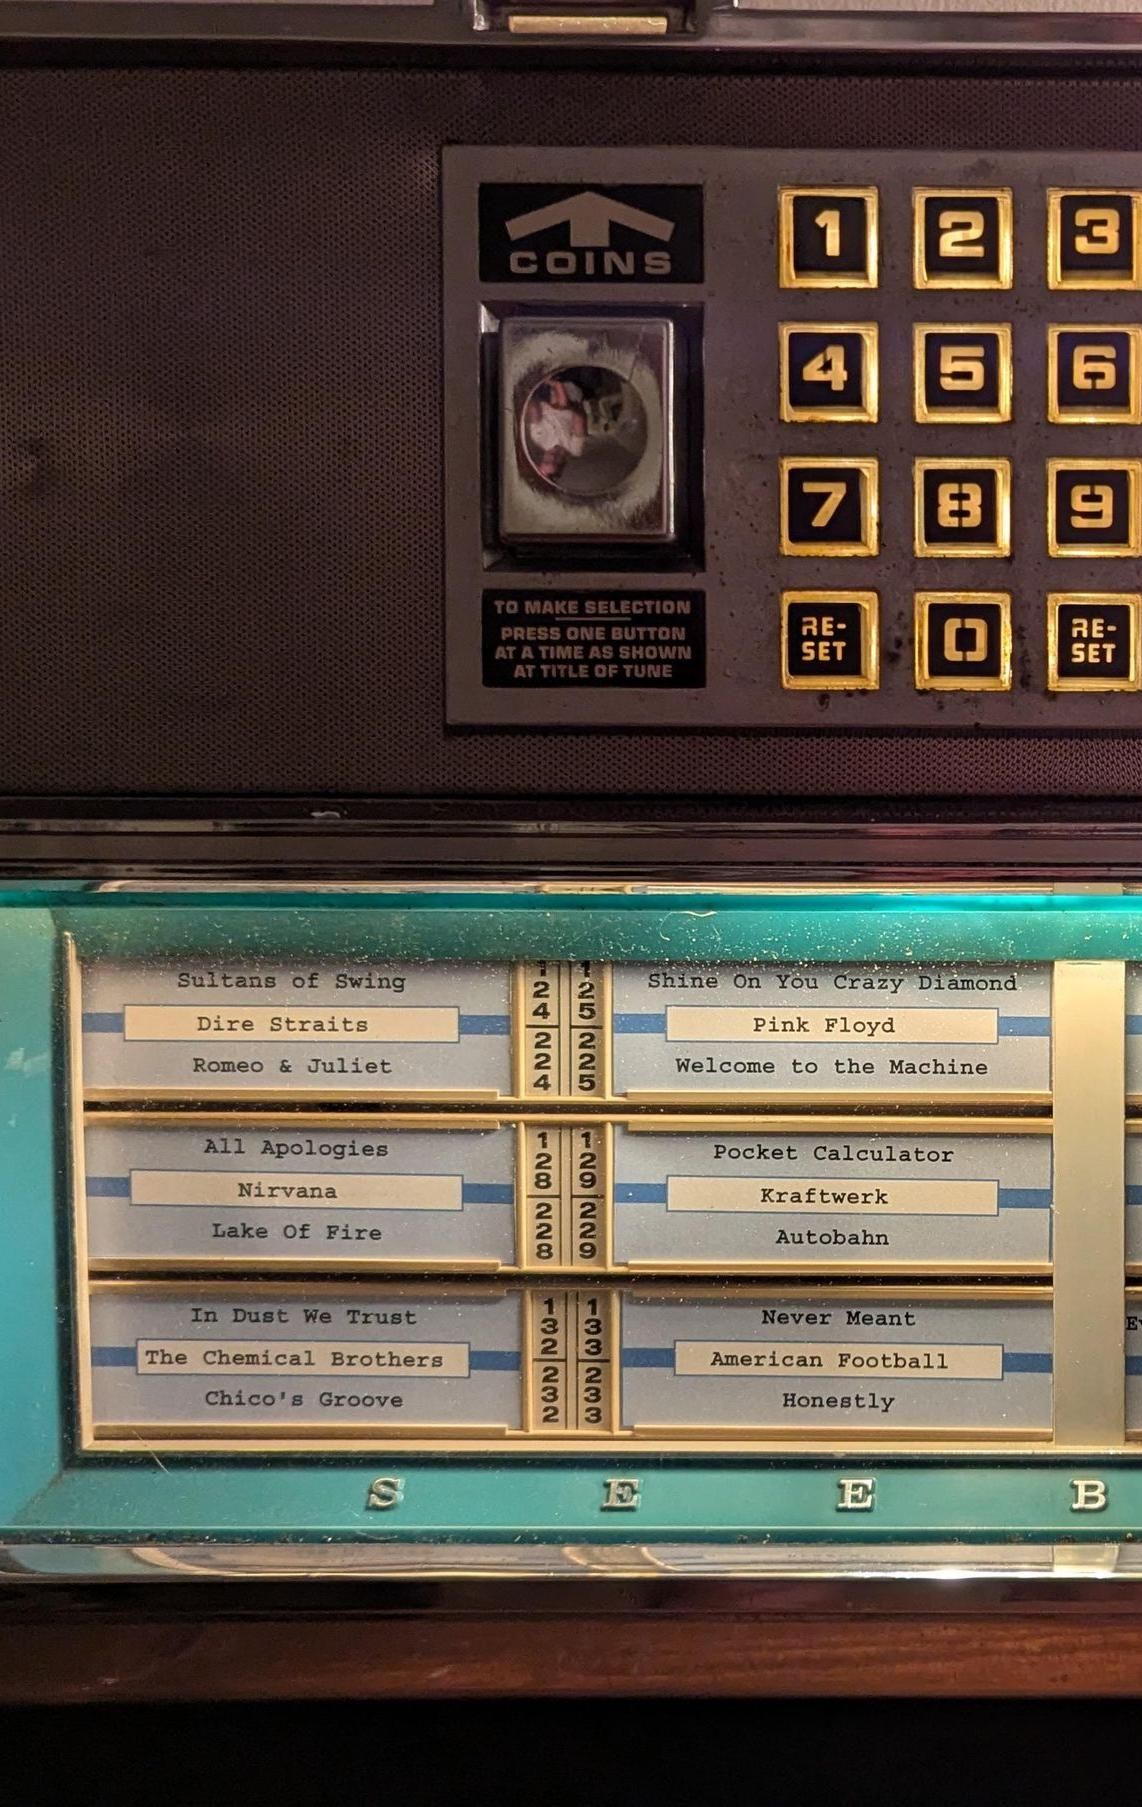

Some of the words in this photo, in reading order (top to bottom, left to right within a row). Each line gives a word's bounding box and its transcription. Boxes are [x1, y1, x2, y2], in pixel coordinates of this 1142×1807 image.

[815, 211, 840, 256] 1
[938, 211, 985, 257] 2
[1075, 209, 1119, 254] 3
[509, 252, 672, 275] COINS
[802, 346, 848, 391] 4
[939, 346, 985, 391] 5
[1072, 346, 1116, 390] 6
[802, 482, 847, 527] 7
[937, 482, 982, 527] 8
[1070, 485, 1114, 528] 9
[494, 601, 518, 614] TO
[525, 601, 578, 614] MAKE
[585, 601, 691, 614] SELECTION
[501, 627, 561, 640] PRESS
[566, 627, 605, 640] ONE
[611, 627, 685, 640] BUTTON
[943, 618, 987, 662] 0
[495, 646, 516, 660] AT
[521, 646, 534, 659] A
[539, 646, 584, 659] TIME
[589, 646, 613, 660] AS
[619, 646, 691, 660] SHOWN
[514, 665, 536, 678] AT
[541, 665, 588, 678] TITLE
[594, 665, 618, 678] OF
[624, 665, 672, 678] TUNE
[178, 973, 276, 990] Sultans
[292, 973, 318, 989] of
[335, 973, 406, 993] Swing
[648, 973, 718, 990] Shine
[734, 974, 761, 990] On
[777, 974, 818, 991] You
[834, 974, 904, 994] Crazy
[919, 974, 1017, 992] Diamond
[198, 1016, 254, 1032] Dire
[270, 1016, 368, 1032] Straits
[754, 1017, 810, 1032] Pink
[826, 1017, 895, 1035] Floyd
[193, 1058, 263, 1073] Romeo
[307, 1058, 393, 1074] Juliet
[675, 1058, 775, 1074] Welcome
[792, 1060, 817, 1074] to
[834, 1059, 875, 1075] the
[889, 1060, 988, 1076] Machine
[204, 1139, 246, 1156] All
[262, 1141, 389, 1161] Apologies
[714, 1145, 797, 1160] Pocket
[813, 1146, 954, 1163] Calculator
[238, 1183, 337, 1199] Nirvana
[760, 1188, 889, 1206] Kraftwerk
[212, 1224, 268, 1240] Lake
[284, 1225, 310, 1240] Of
[326, 1225, 383, 1242] Fire
[776, 1229, 890, 1246] Autobahn
[190, 1309, 219, 1323] In
[233, 1309, 288, 1324] Dust
[304, 1309, 332, 1324] We
[347, 1310, 417, 1325] Trust
[762, 1311, 831, 1325] Never
[846, 1311, 916, 1327] Meant
[146, 1351, 188, 1366] The
[202, 1350, 316, 1367] Chemical
[331, 1351, 443, 1369] Brothers
[710, 1352, 823, 1369] American
[838, 1353, 949, 1370] Football
[205, 1391, 304, 1408] Chico's
[319, 1393, 403, 1409] Groove
[782, 1394, 895, 1413] Honestly
